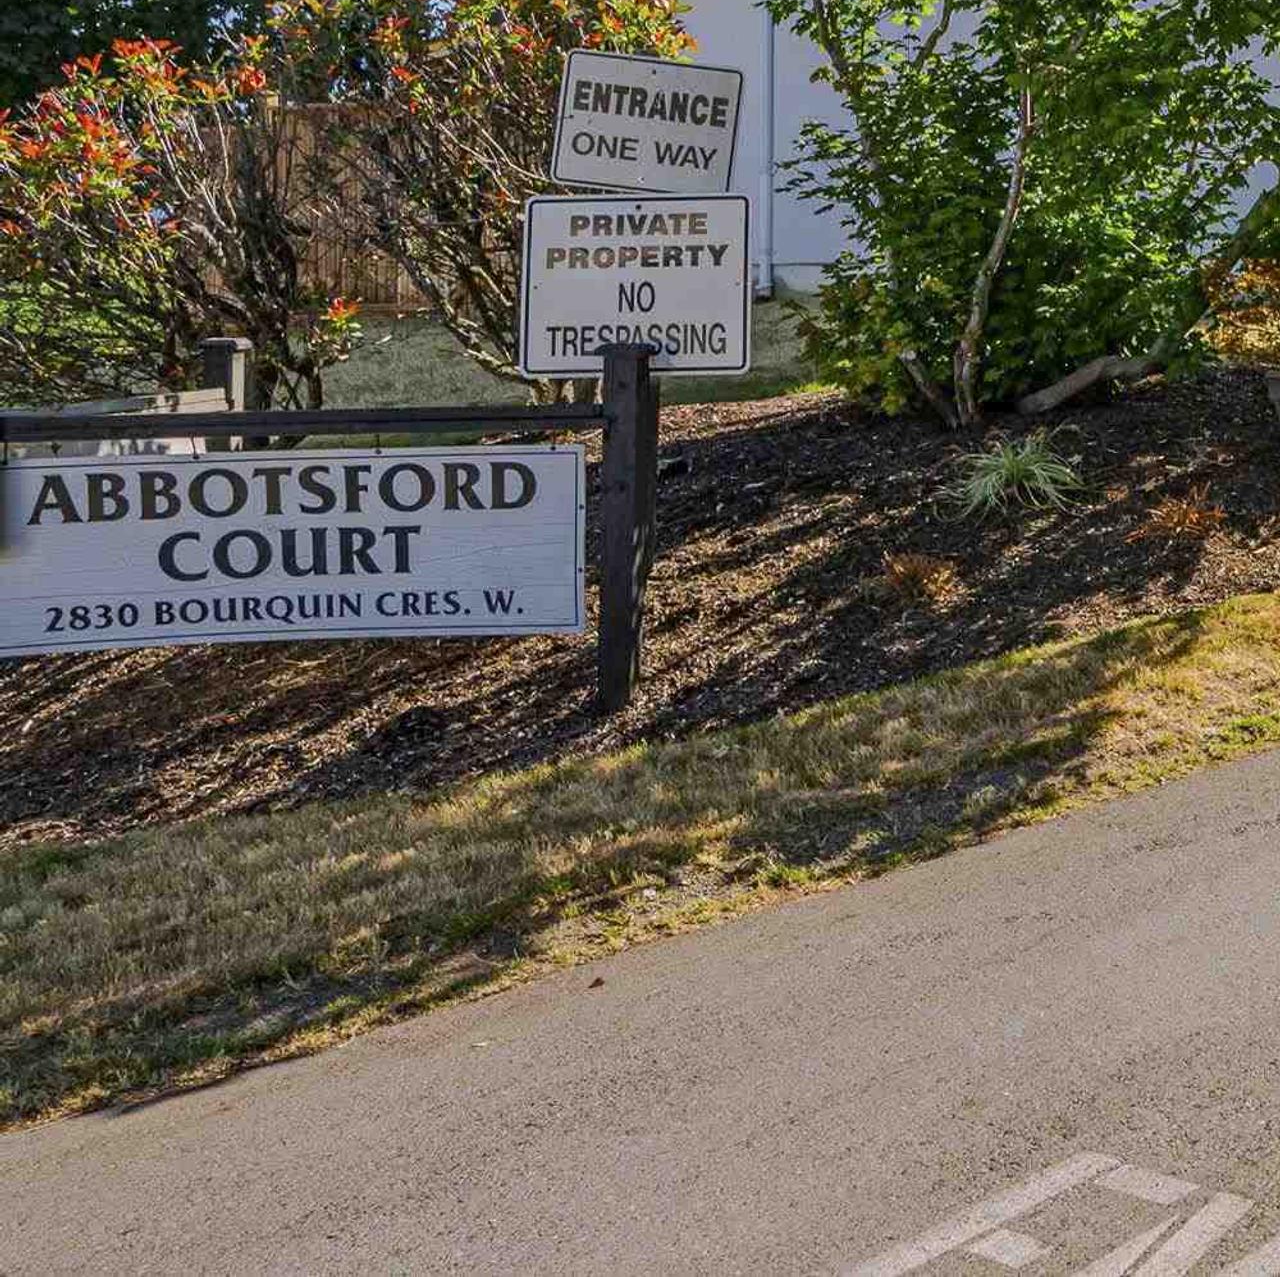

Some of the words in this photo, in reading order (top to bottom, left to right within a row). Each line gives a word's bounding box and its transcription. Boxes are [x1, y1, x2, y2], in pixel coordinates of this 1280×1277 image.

[573, 80, 729, 128] ENTRANCE
[571, 132, 638, 161] ONE
[655, 141, 717, 170] WAY
[570, 212, 709, 237] PRIVATE
[546, 244, 729, 270] PROPERTY
[618, 282, 656, 314] NO
[26, 462, 537, 526] ABBOTSFORD
[157, 525, 422, 583] COURT
[45, 602, 140, 633] 2830
[155, 592, 362, 626] BOURQUIN
[375, 589, 472, 619] CRES.
[484, 589, 524, 616] W.
